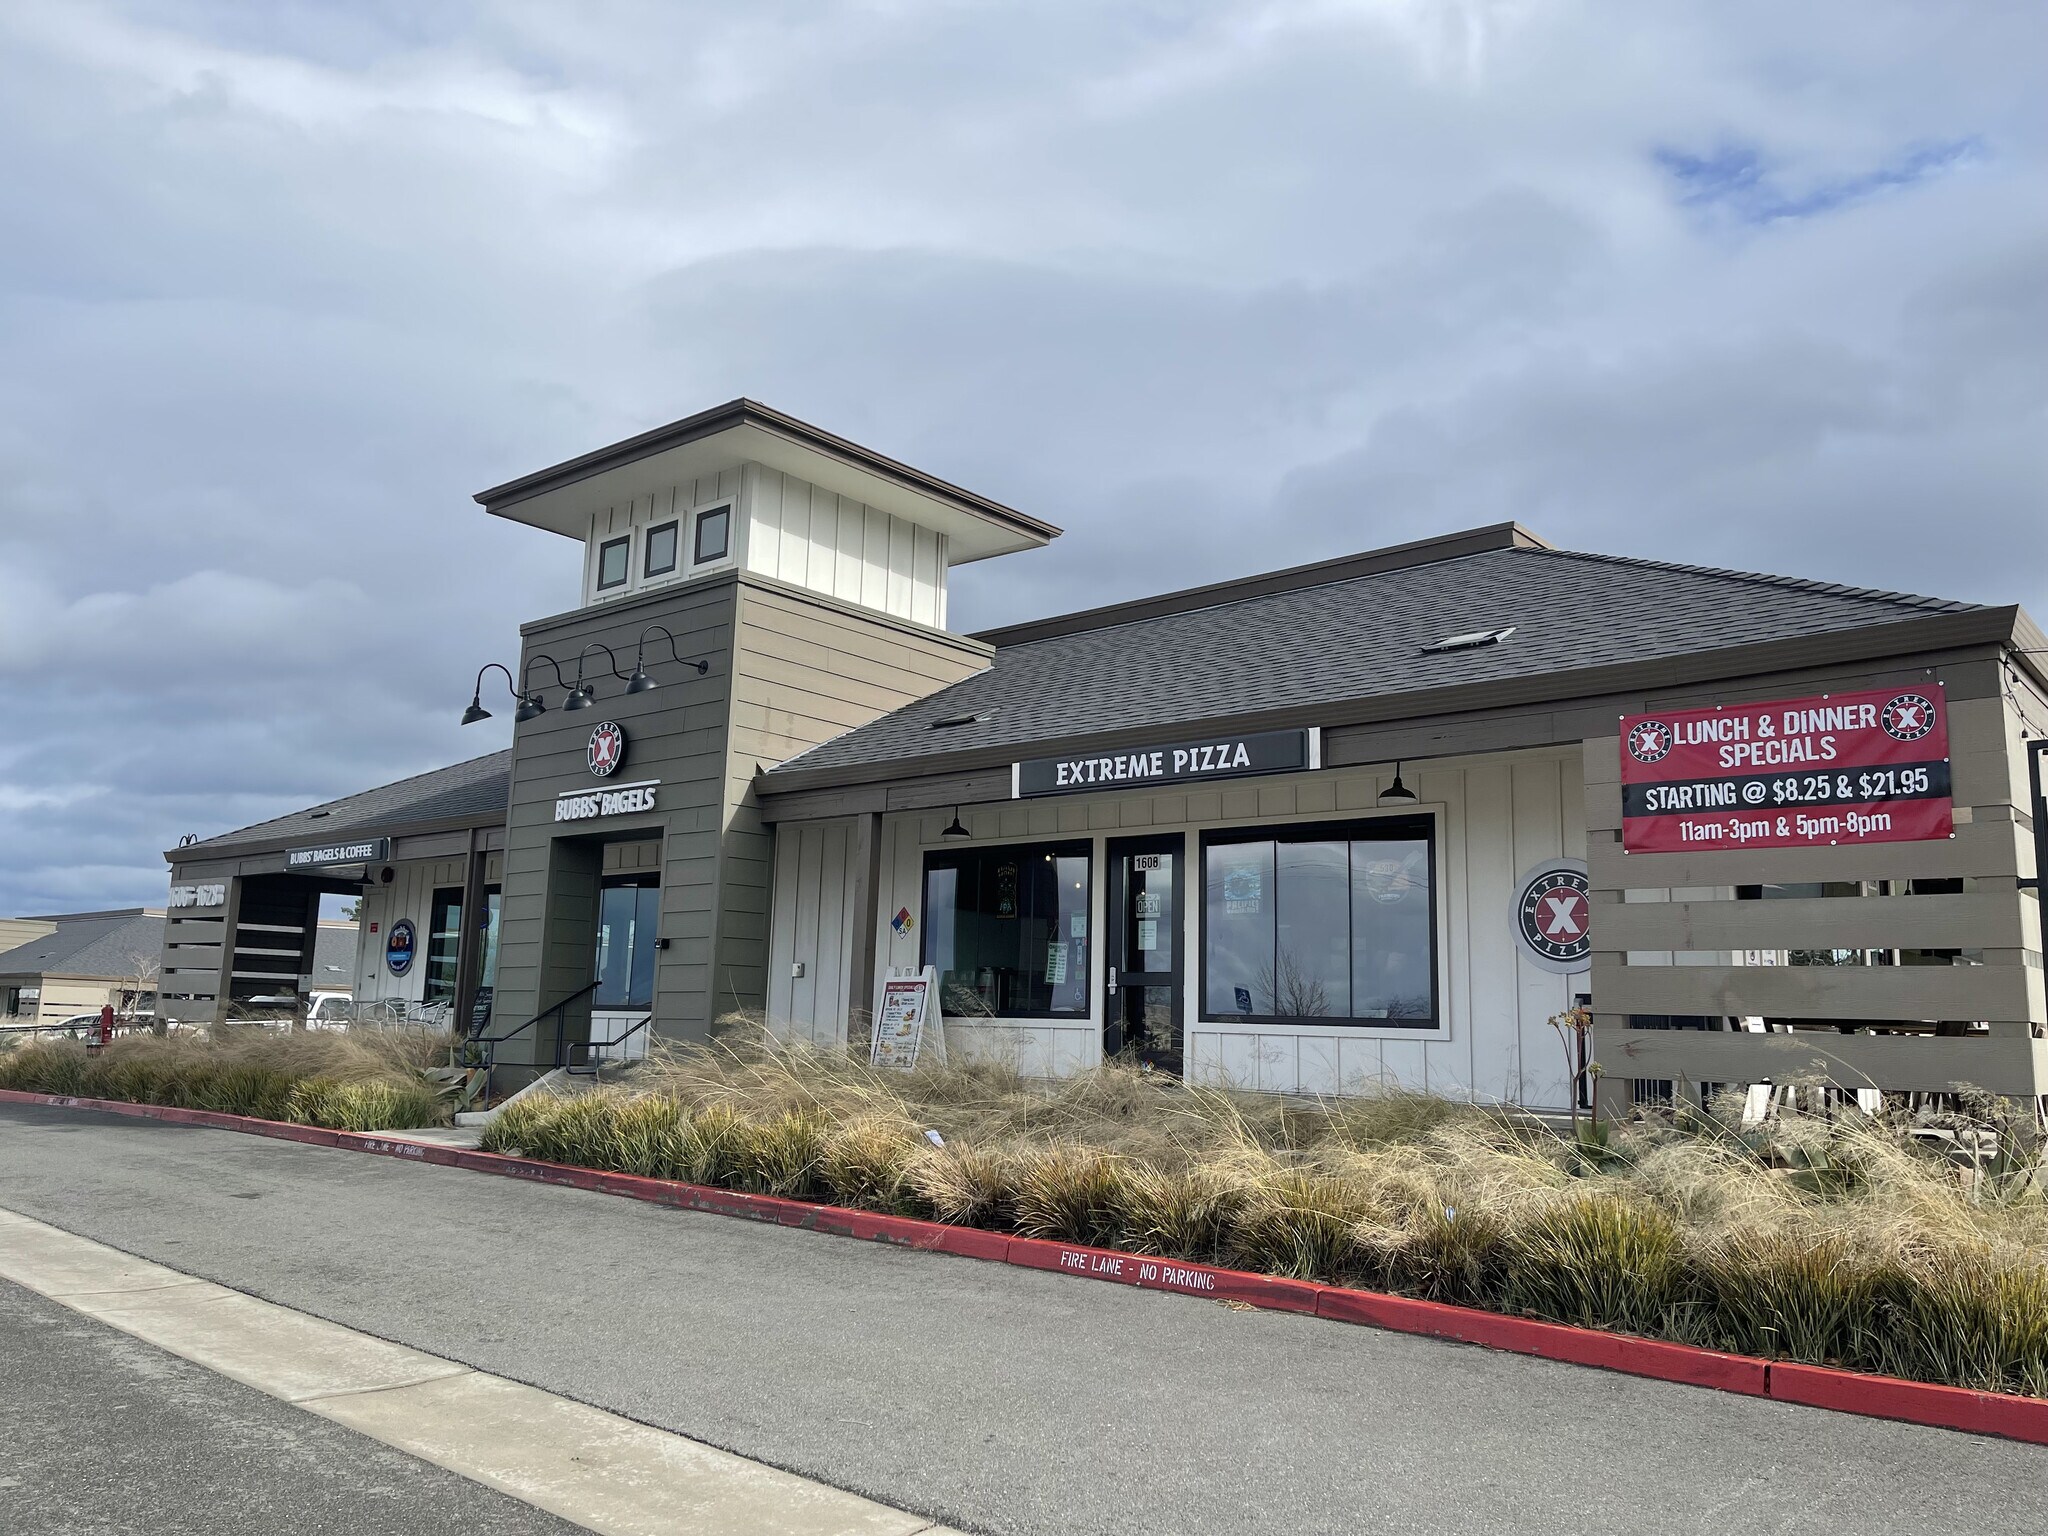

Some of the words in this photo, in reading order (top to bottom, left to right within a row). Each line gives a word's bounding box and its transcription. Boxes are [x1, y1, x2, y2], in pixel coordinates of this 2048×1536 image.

[1673, 716, 1749, 745] LUNCH
[1757, 714, 1775, 738] &
[1783, 703, 1877, 735] DINNER
[1895, 706, 1920, 729] X
[596, 736, 613, 762] X
[1640, 732, 1659, 752] X
[1718, 735, 1837, 769] SPECIALS
[1056, 752, 1163, 786] EXTREME
[1173, 742, 1250, 774] PIZZA
[1645, 781, 1736, 811] STARTING
[1742, 781, 1767, 804] @
[1772, 775, 1831, 805] $8.25
[1836, 775, 1853, 799] &
[1859, 767, 1929, 800] $21.95
[555, 792, 602, 821] BUBBS'
[601, 787, 656, 816] BAGELS
[1679, 817, 1770, 843] 11am-3pm
[1776, 816, 1790, 837] &
[1796, 811, 1891, 841] 5pm-8pm
[313, 847, 340, 862] BAGELS
[339, 847, 346, 859] &
[345, 844, 373, 858] COFFEE
[1136, 856, 1159, 869] 1608
[1137, 900, 1159, 913] OPEN
[1544, 897, 1581, 934] X
[906, 918, 911, 928] 0
[1533, 932, 1590, 955] PIZZ
[1060, 1251, 1088, 1270] FIRE
[1091, 1255, 1124, 1276] LANE
[1139, 1263, 1158, 1281] NO
[1162, 1266, 1215, 1291] PARKING
